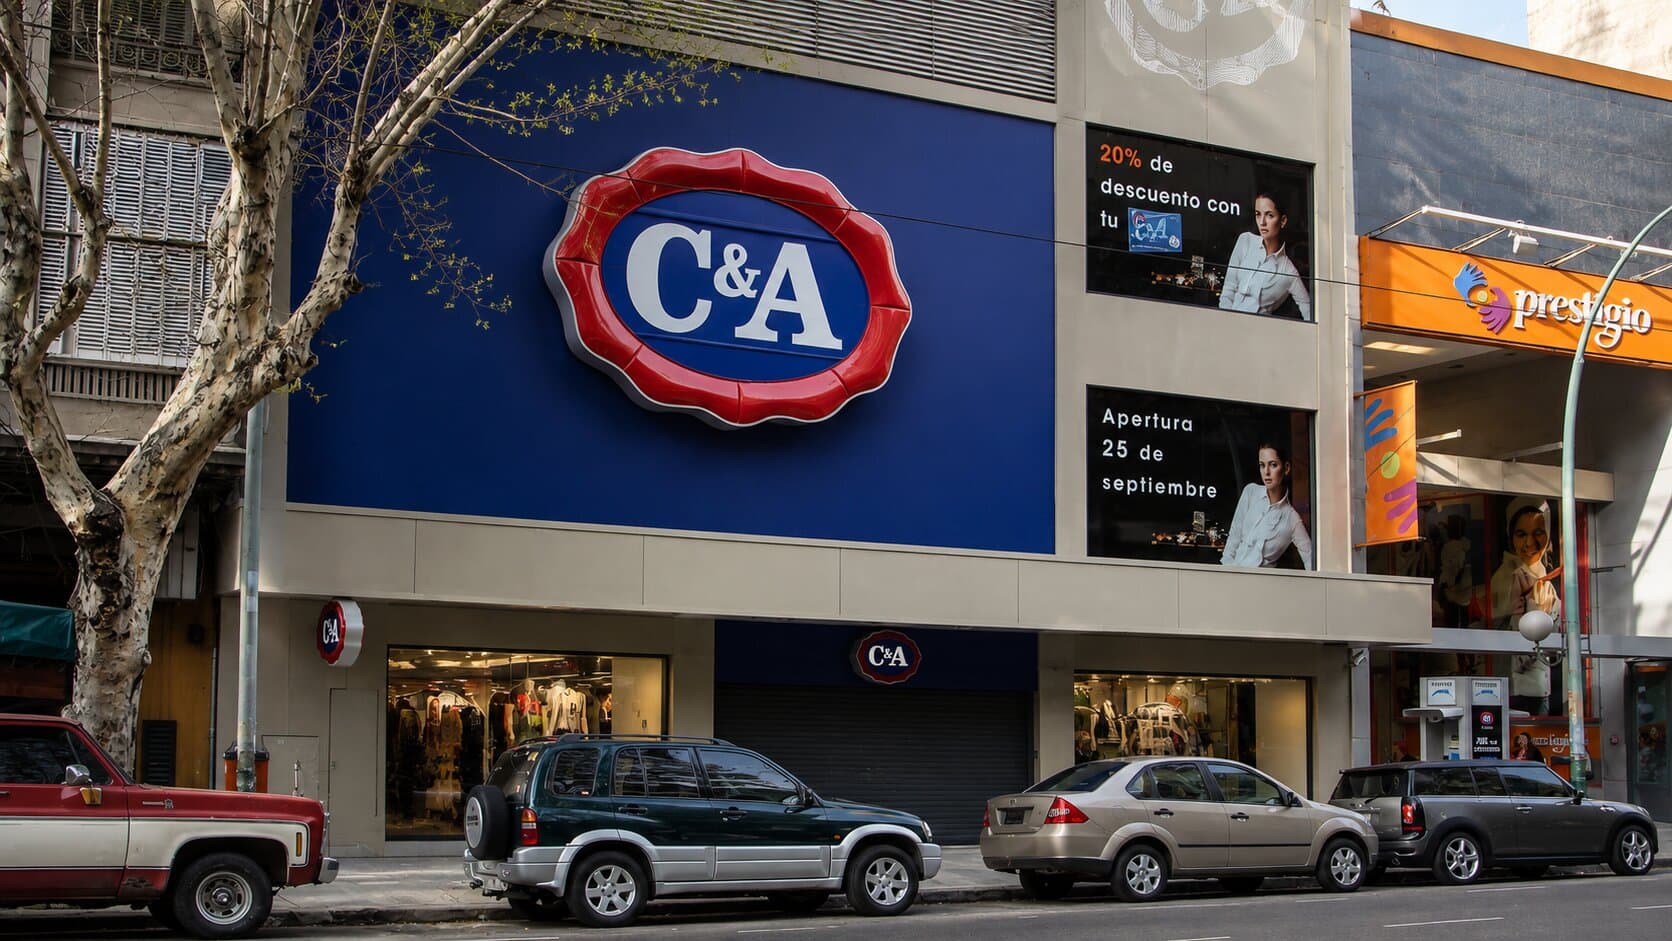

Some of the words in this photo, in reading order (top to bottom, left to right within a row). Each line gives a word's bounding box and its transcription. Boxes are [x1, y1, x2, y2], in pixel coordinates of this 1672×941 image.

[1101, 144, 1142, 168] 20%
[1150, 155, 1173, 174] de
[1101, 178, 1201, 209] descuento
[1207, 198, 1241, 216] con
[1100, 210, 1119, 229] tu
[626, 222, 843, 350] C&A
[1102, 407, 1193, 432] Apertura
[1102, 438, 1128, 458] 25
[1139, 444, 1164, 462] de
[1102, 476, 1217, 498] septiembre
[322, 618, 340, 645] C&A
[868, 645, 909, 667] C&A
